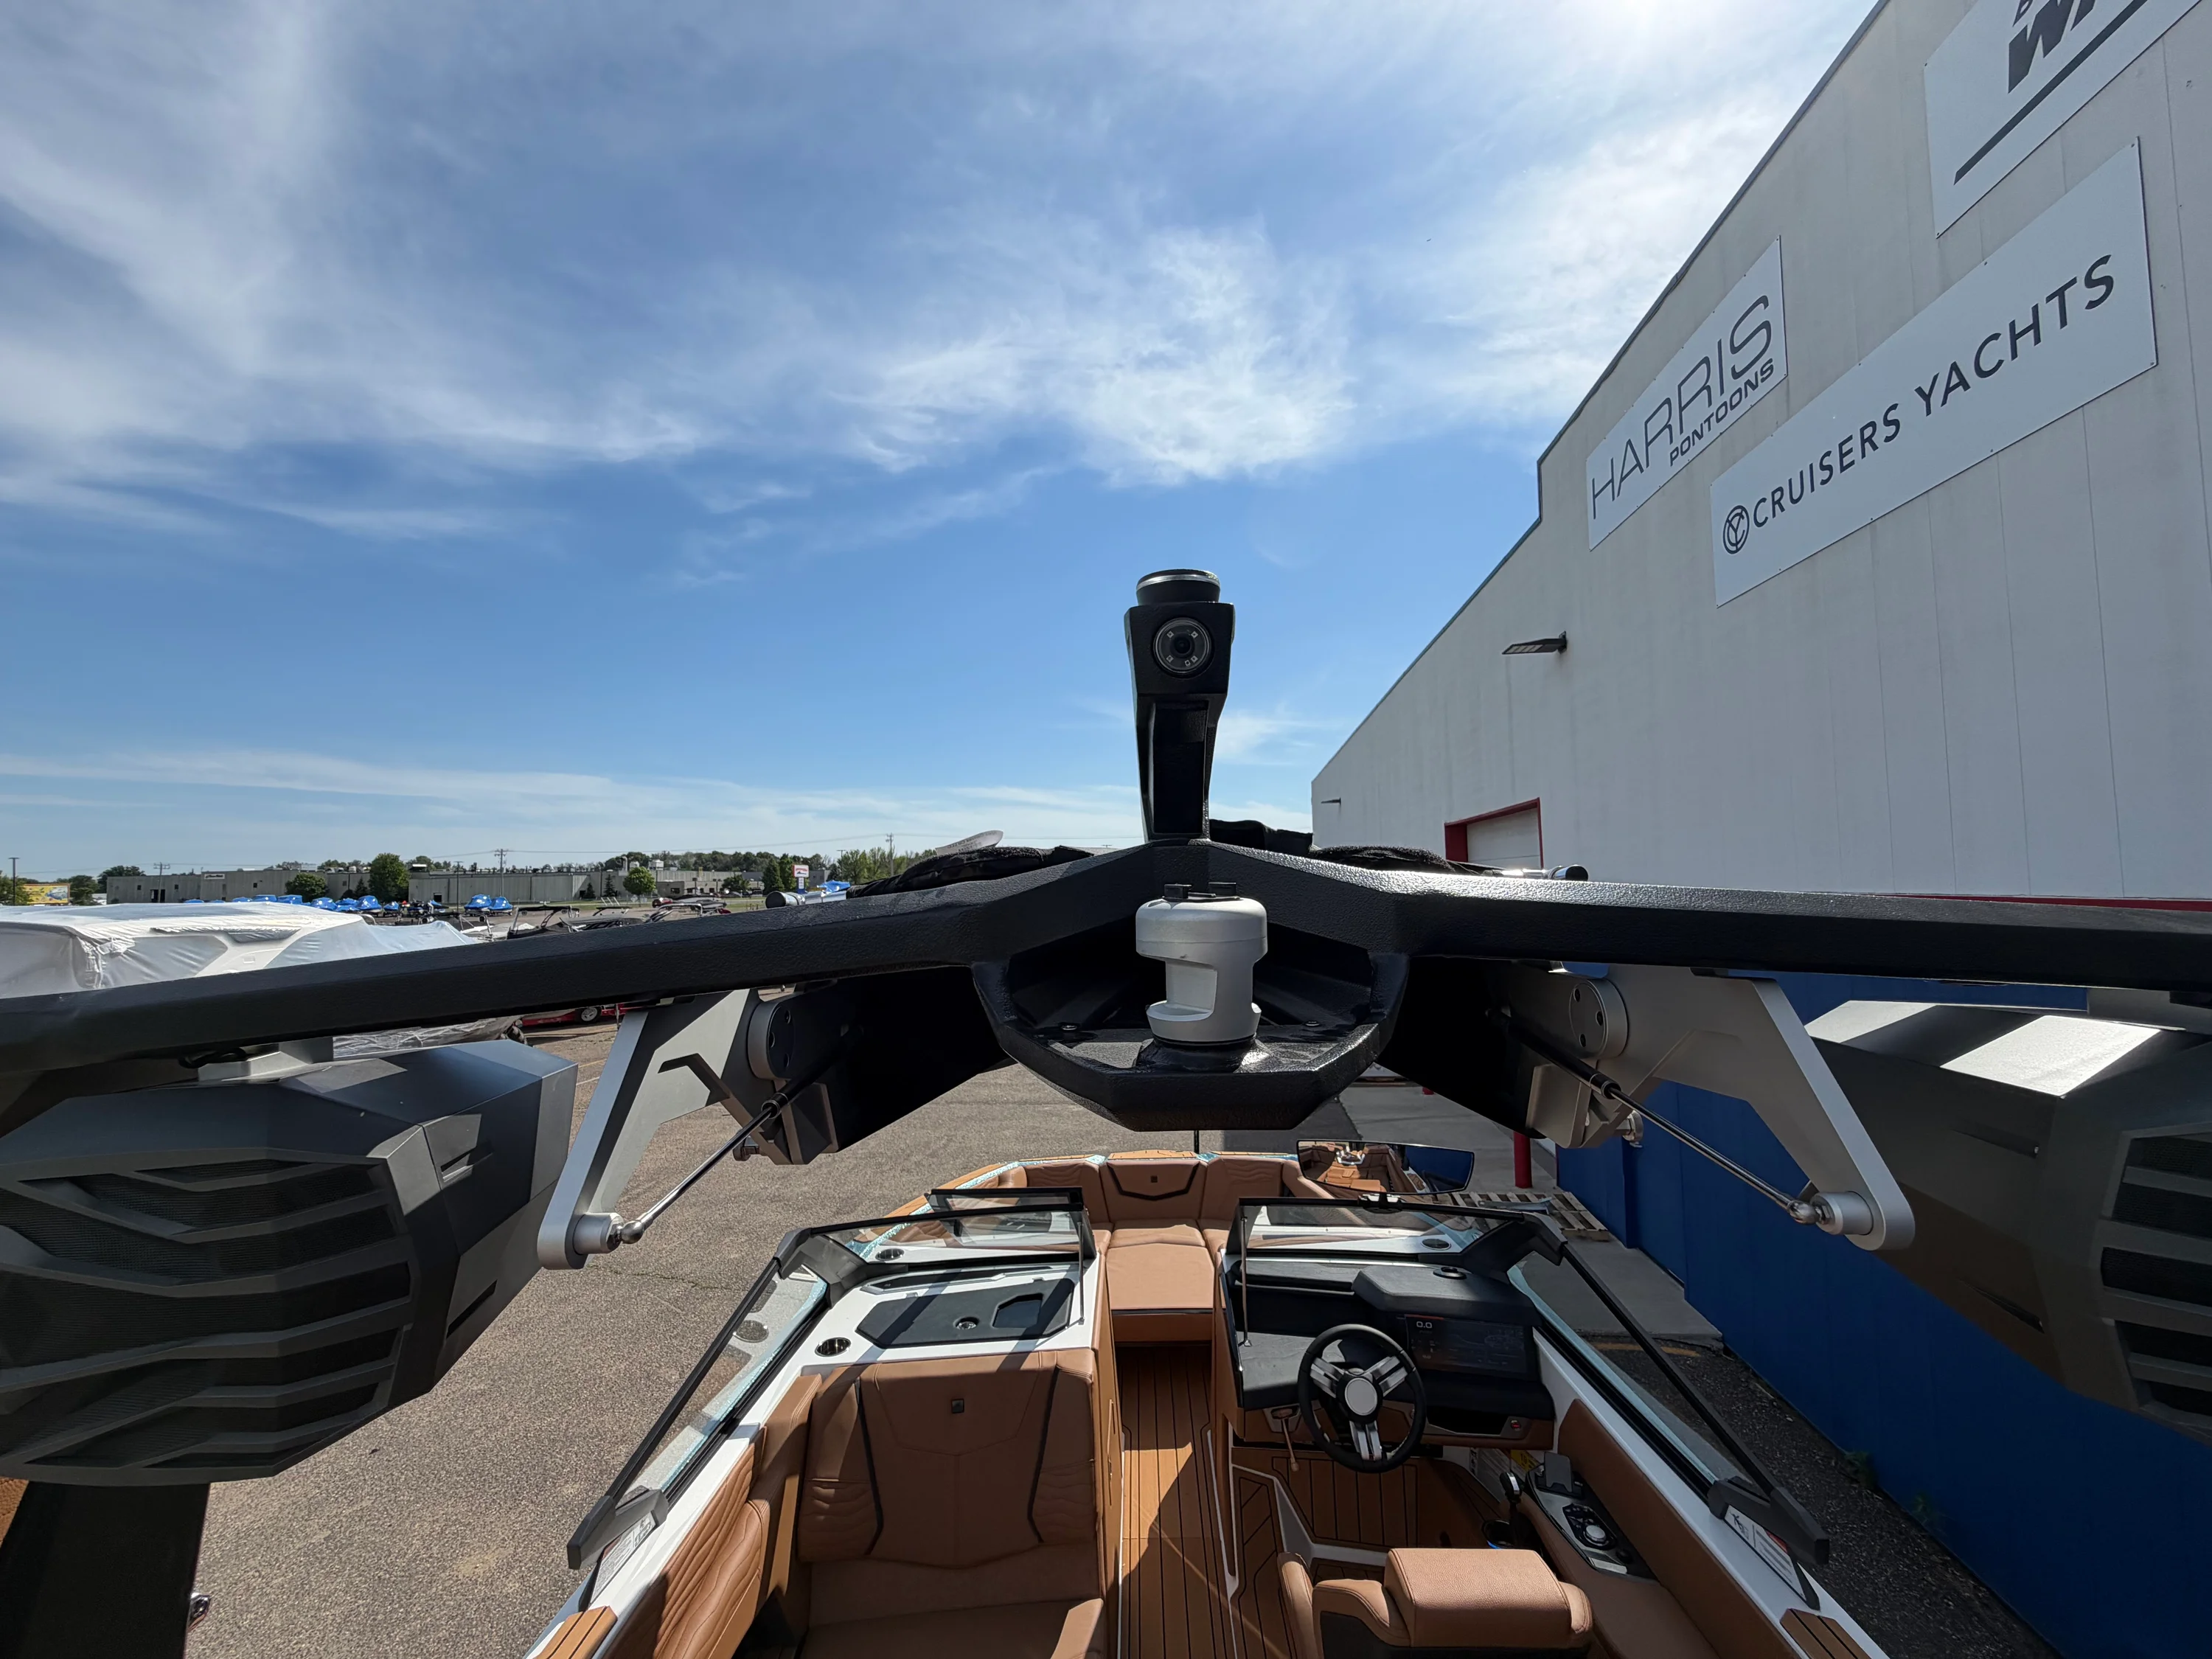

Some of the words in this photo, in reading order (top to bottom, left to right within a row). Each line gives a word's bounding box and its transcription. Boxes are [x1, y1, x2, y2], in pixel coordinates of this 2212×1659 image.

[1592, 295, 1771, 520] HARRIS
[1669, 358, 1774, 467] PONTOONS
[1753, 403, 1900, 527] CRUISERS
[1914, 254, 2114, 417] YACHTS
[1416, 1321, 1433, 1329] 0.0
